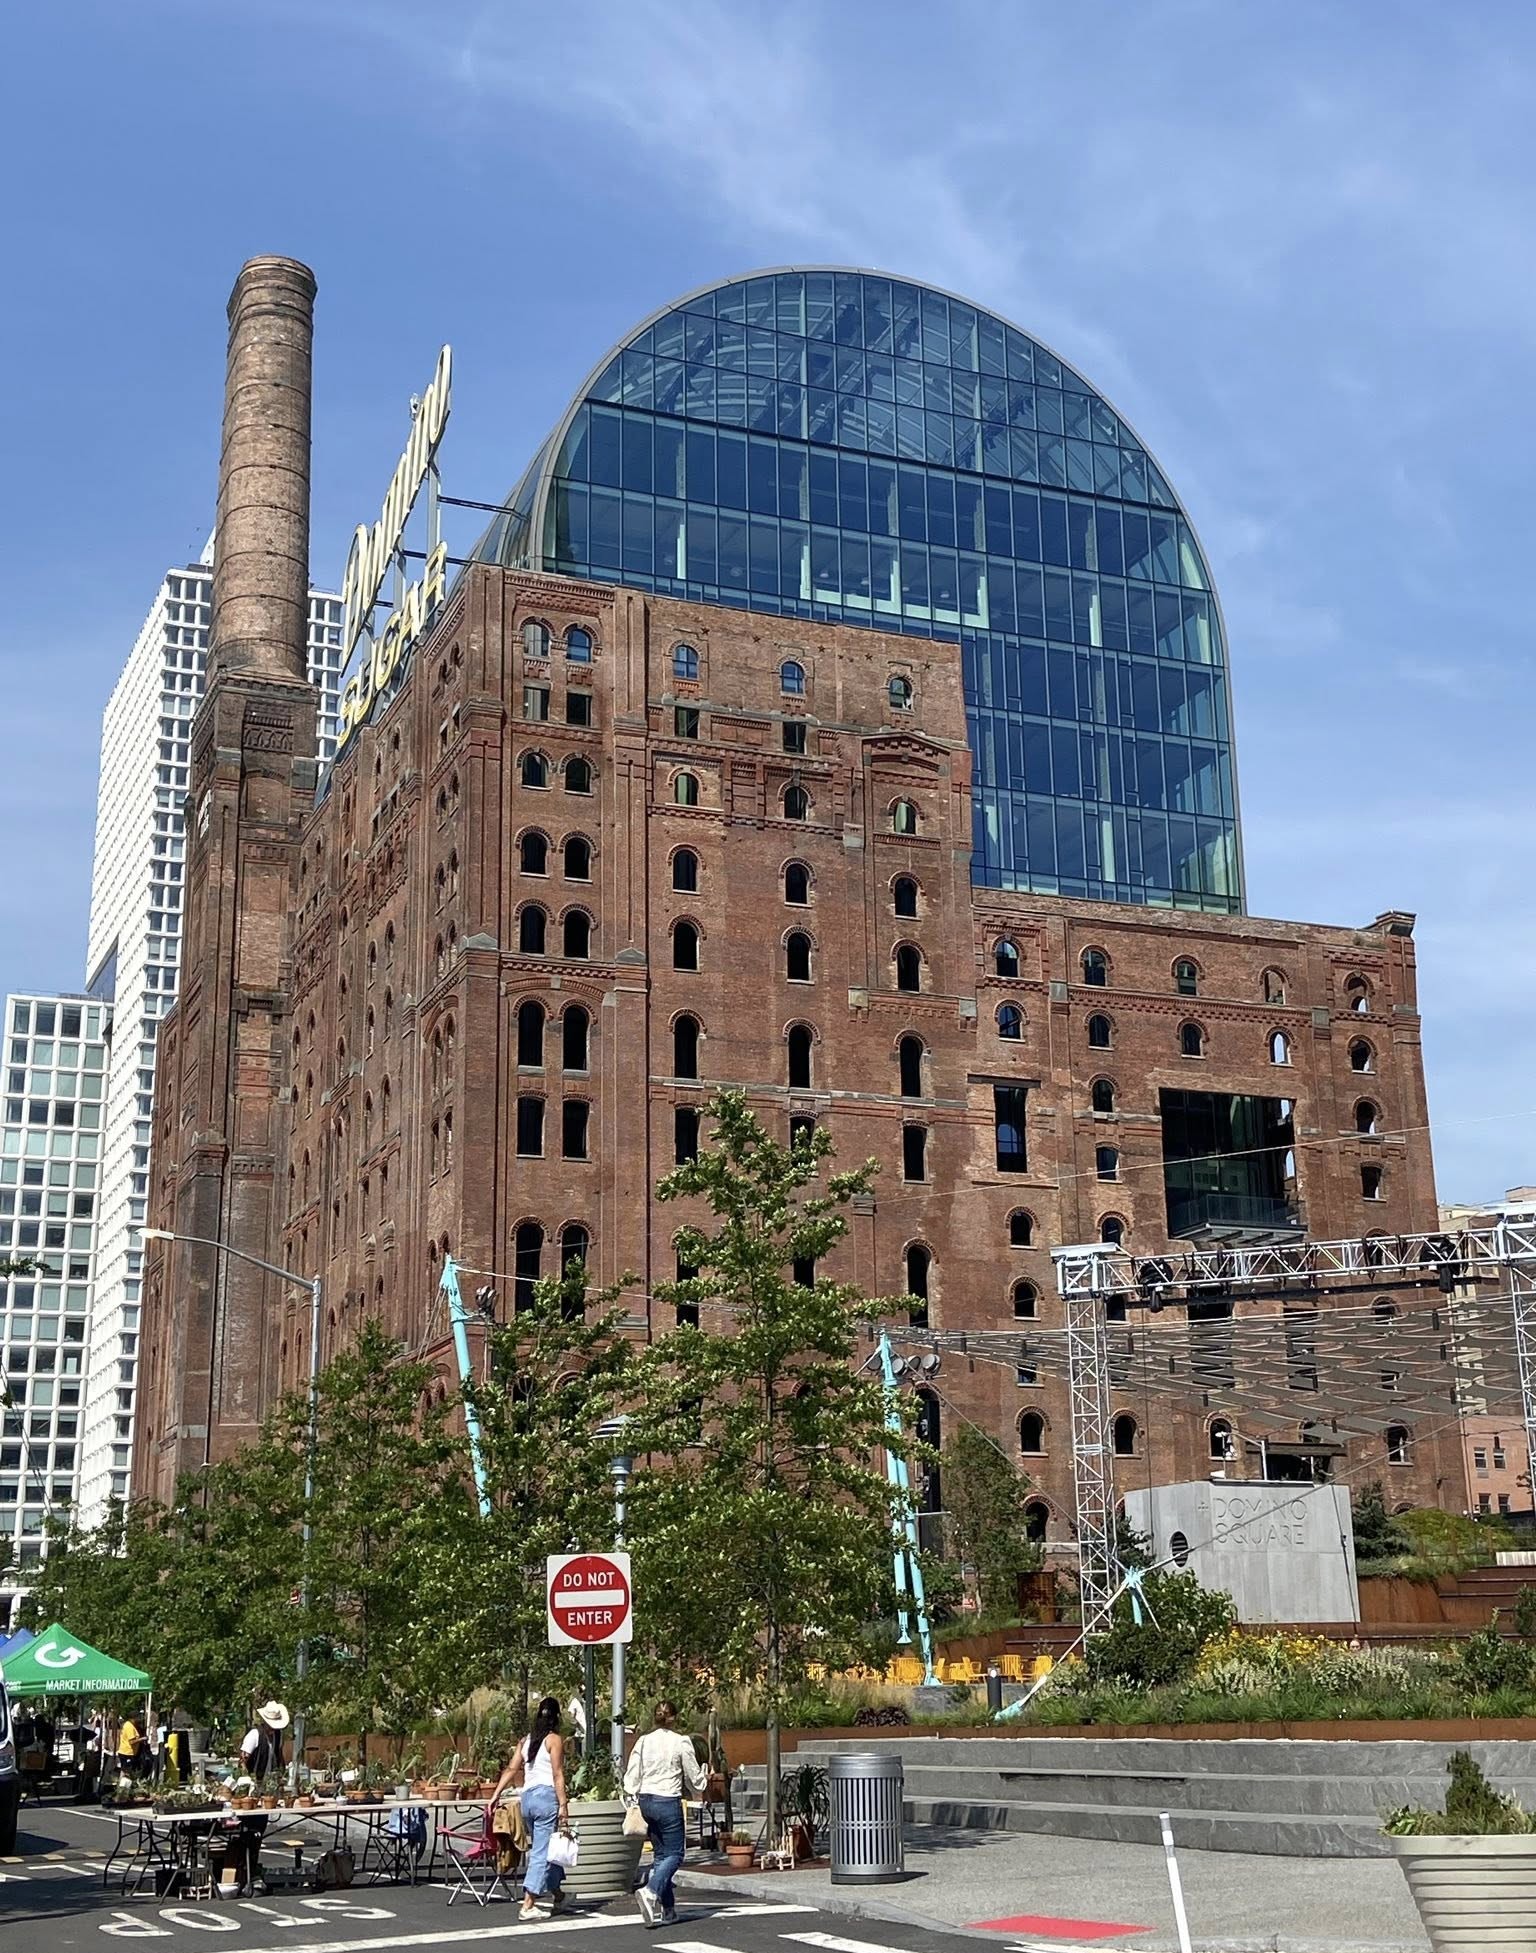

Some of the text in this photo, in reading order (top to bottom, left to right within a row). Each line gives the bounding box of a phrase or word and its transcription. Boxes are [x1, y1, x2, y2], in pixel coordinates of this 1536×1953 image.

[337, 541, 447, 748] SUGAR
[1213, 1497, 1308, 1520] DOMINO
[1214, 1522, 1305, 1545] SQUARE
[563, 1572, 615, 1587] DO NOT
[567, 1611, 613, 1626] ENTER
[46, 1678, 140, 1691] MARKET INFORMATION
[98, 1898, 398, 1938] STOP
